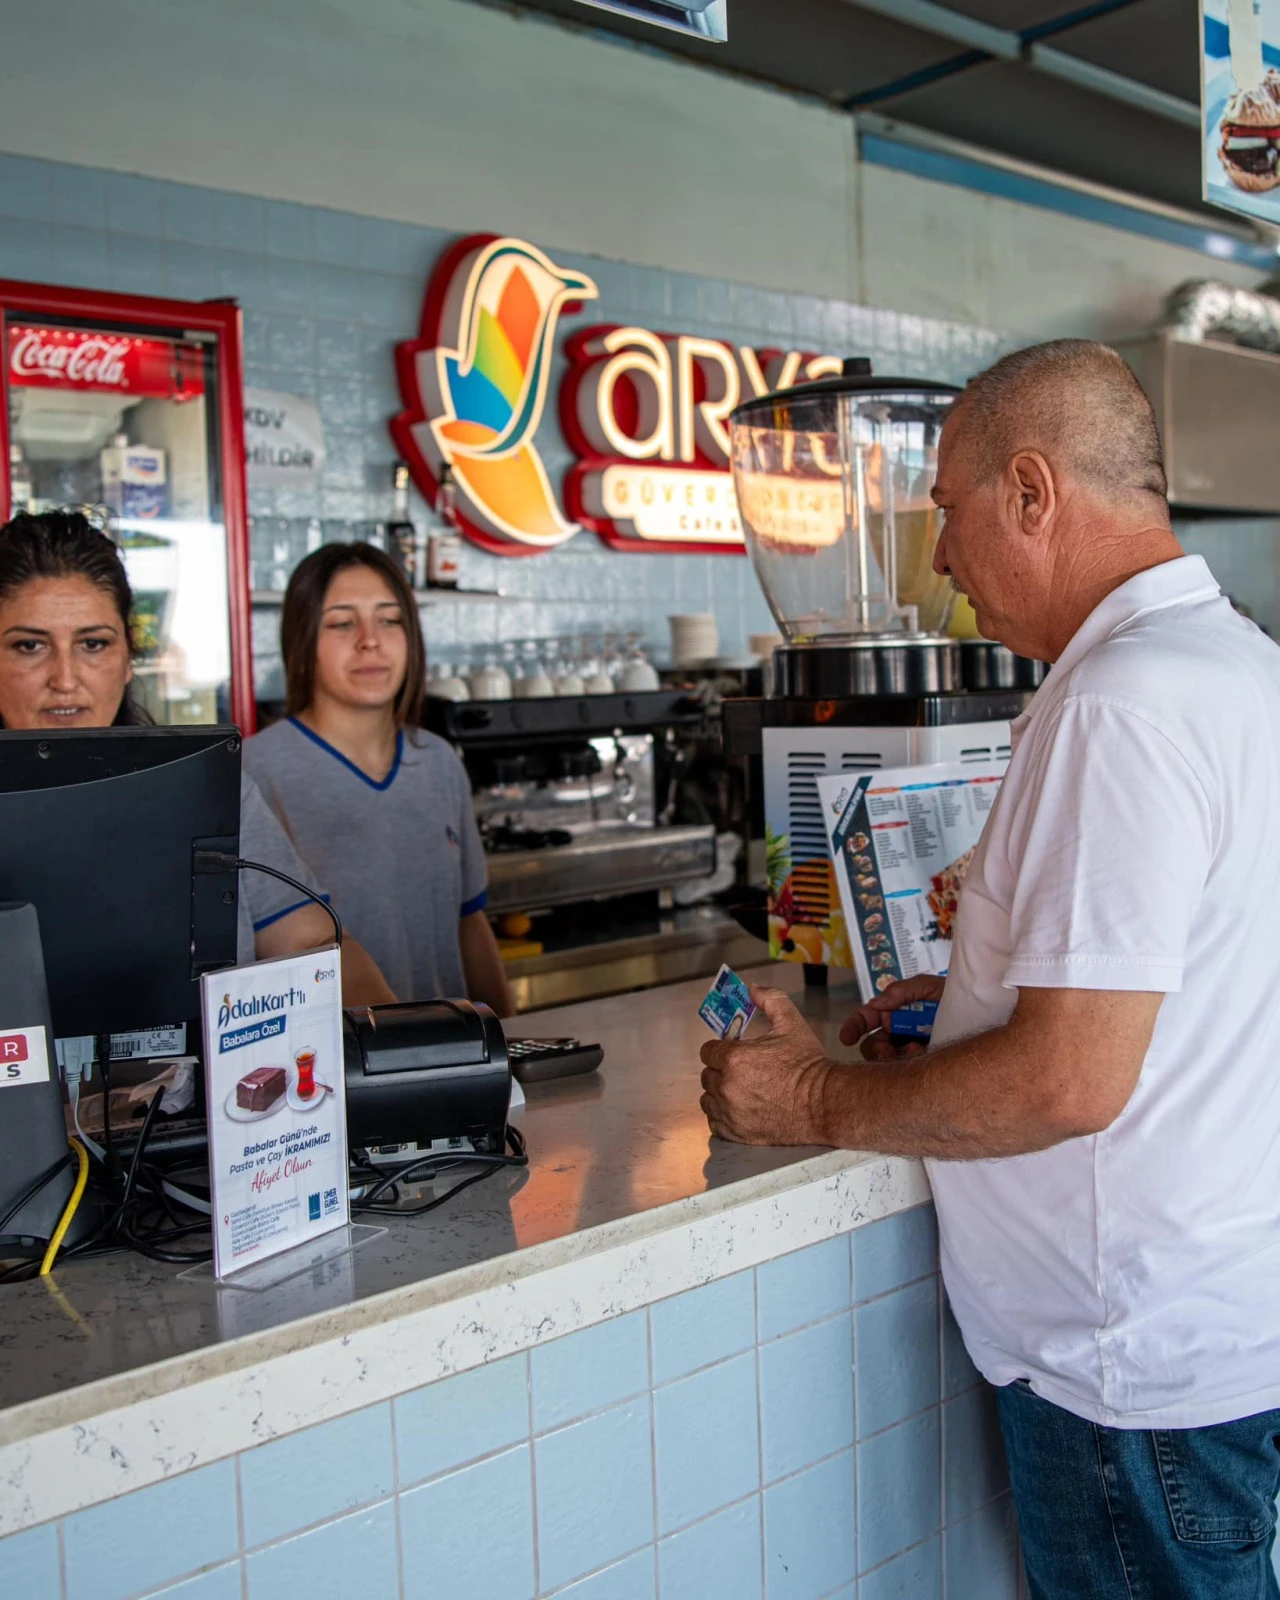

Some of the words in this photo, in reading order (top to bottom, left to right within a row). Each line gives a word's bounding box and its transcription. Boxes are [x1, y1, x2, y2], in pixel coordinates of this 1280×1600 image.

[223, 1030, 260, 1049] Babalara
[261, 1021, 280, 1037] Özel
[229, 1161, 254, 1175] Pasta
[256, 1157, 266, 1166] ve
[267, 1151, 283, 1164] Çay
[284, 1132, 331, 1156] İKRAMIMIZ!
[243, 1138, 278, 1157] Babalar
[279, 1125, 318, 1144] Günü'nde
[251, 1167, 281, 1193] Afiyet
[284, 1157, 312, 1178] Olsun
